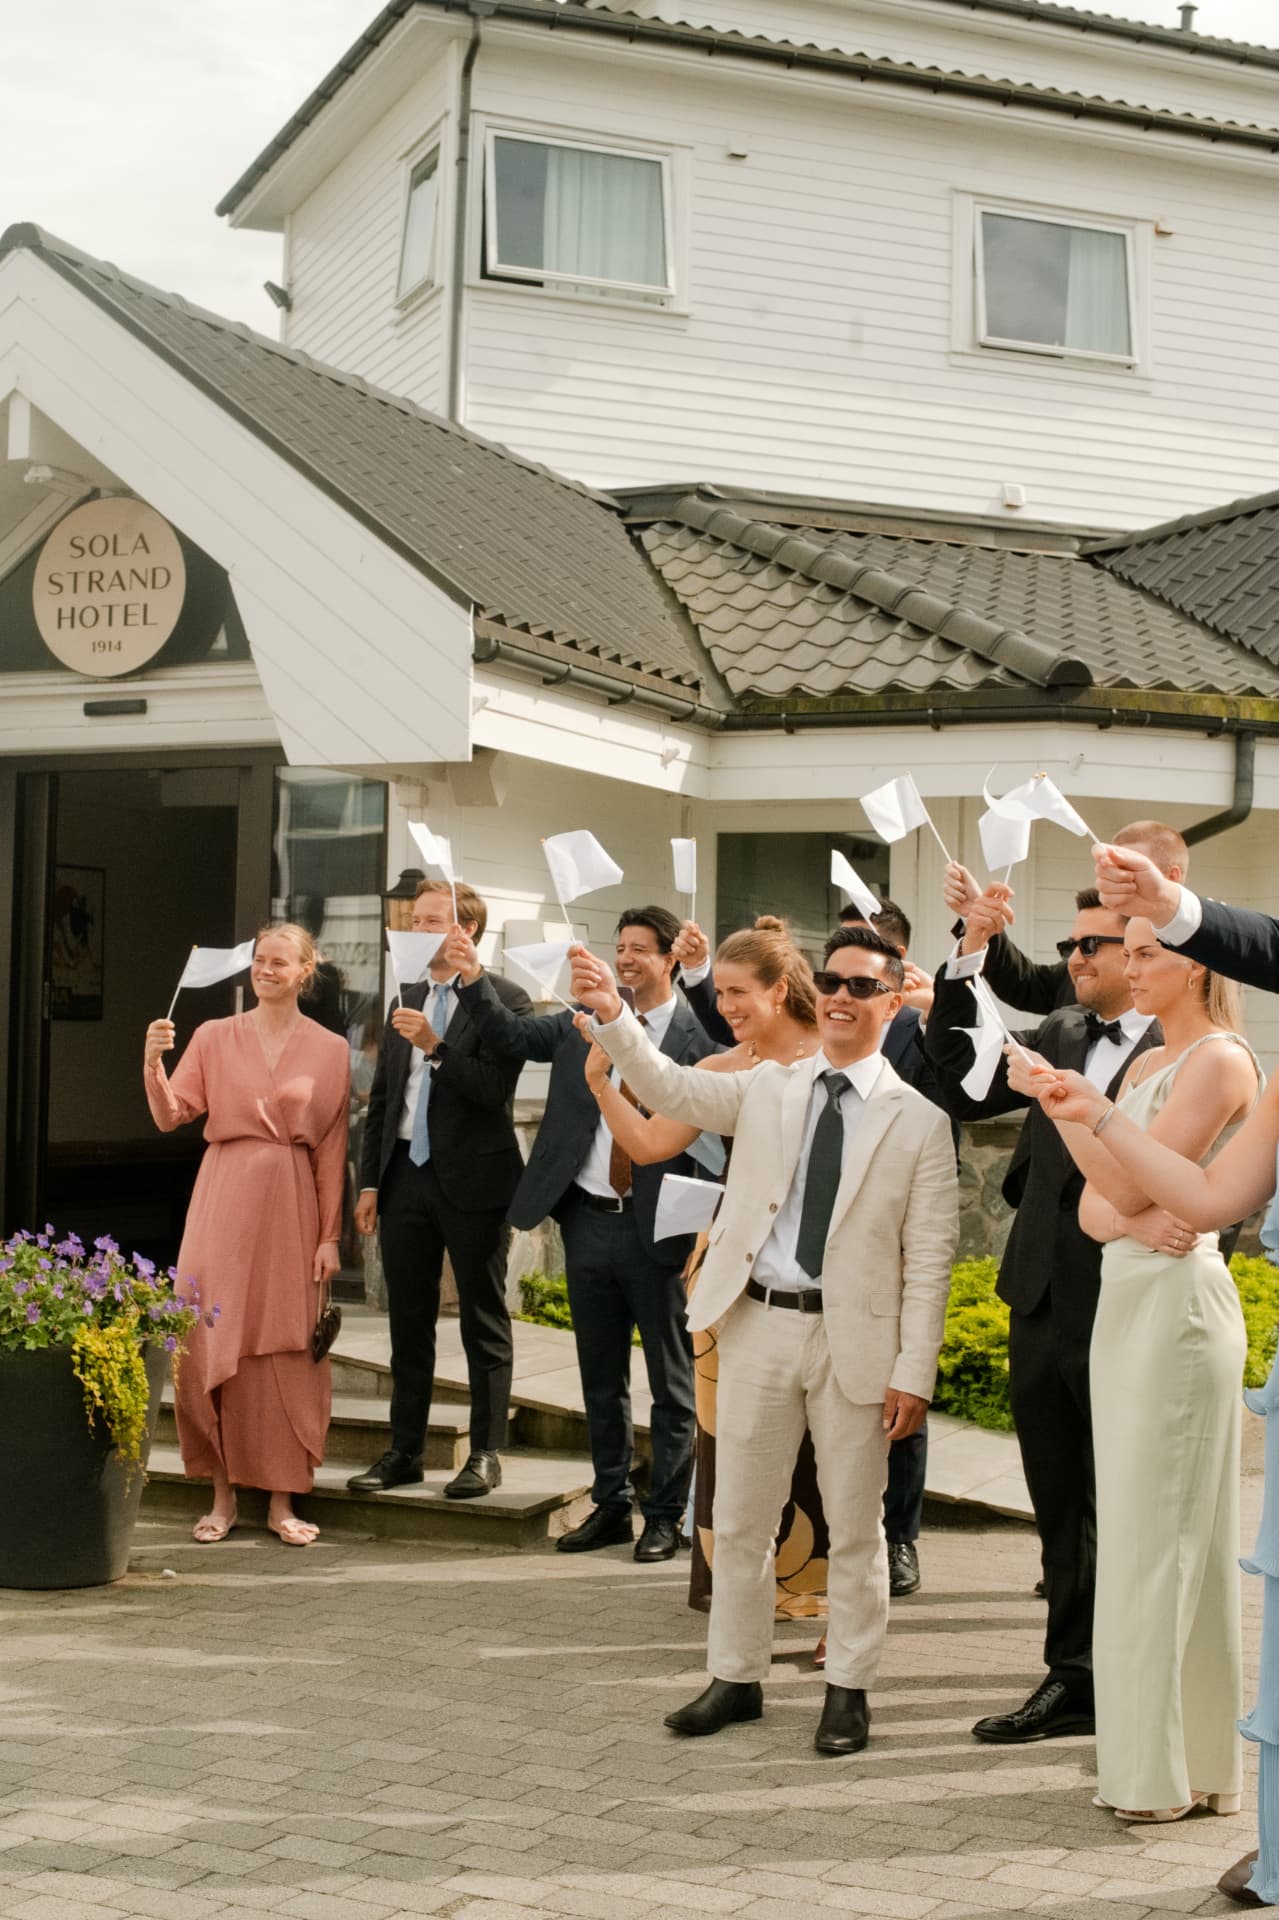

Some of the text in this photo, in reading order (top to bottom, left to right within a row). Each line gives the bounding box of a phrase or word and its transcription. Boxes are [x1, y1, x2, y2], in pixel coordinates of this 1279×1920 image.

[69, 531, 151, 559] SOLA
[47, 566, 172, 596] STRAND
[56, 602, 160, 630] HOTEL
[91, 640, 122, 653] 1914
